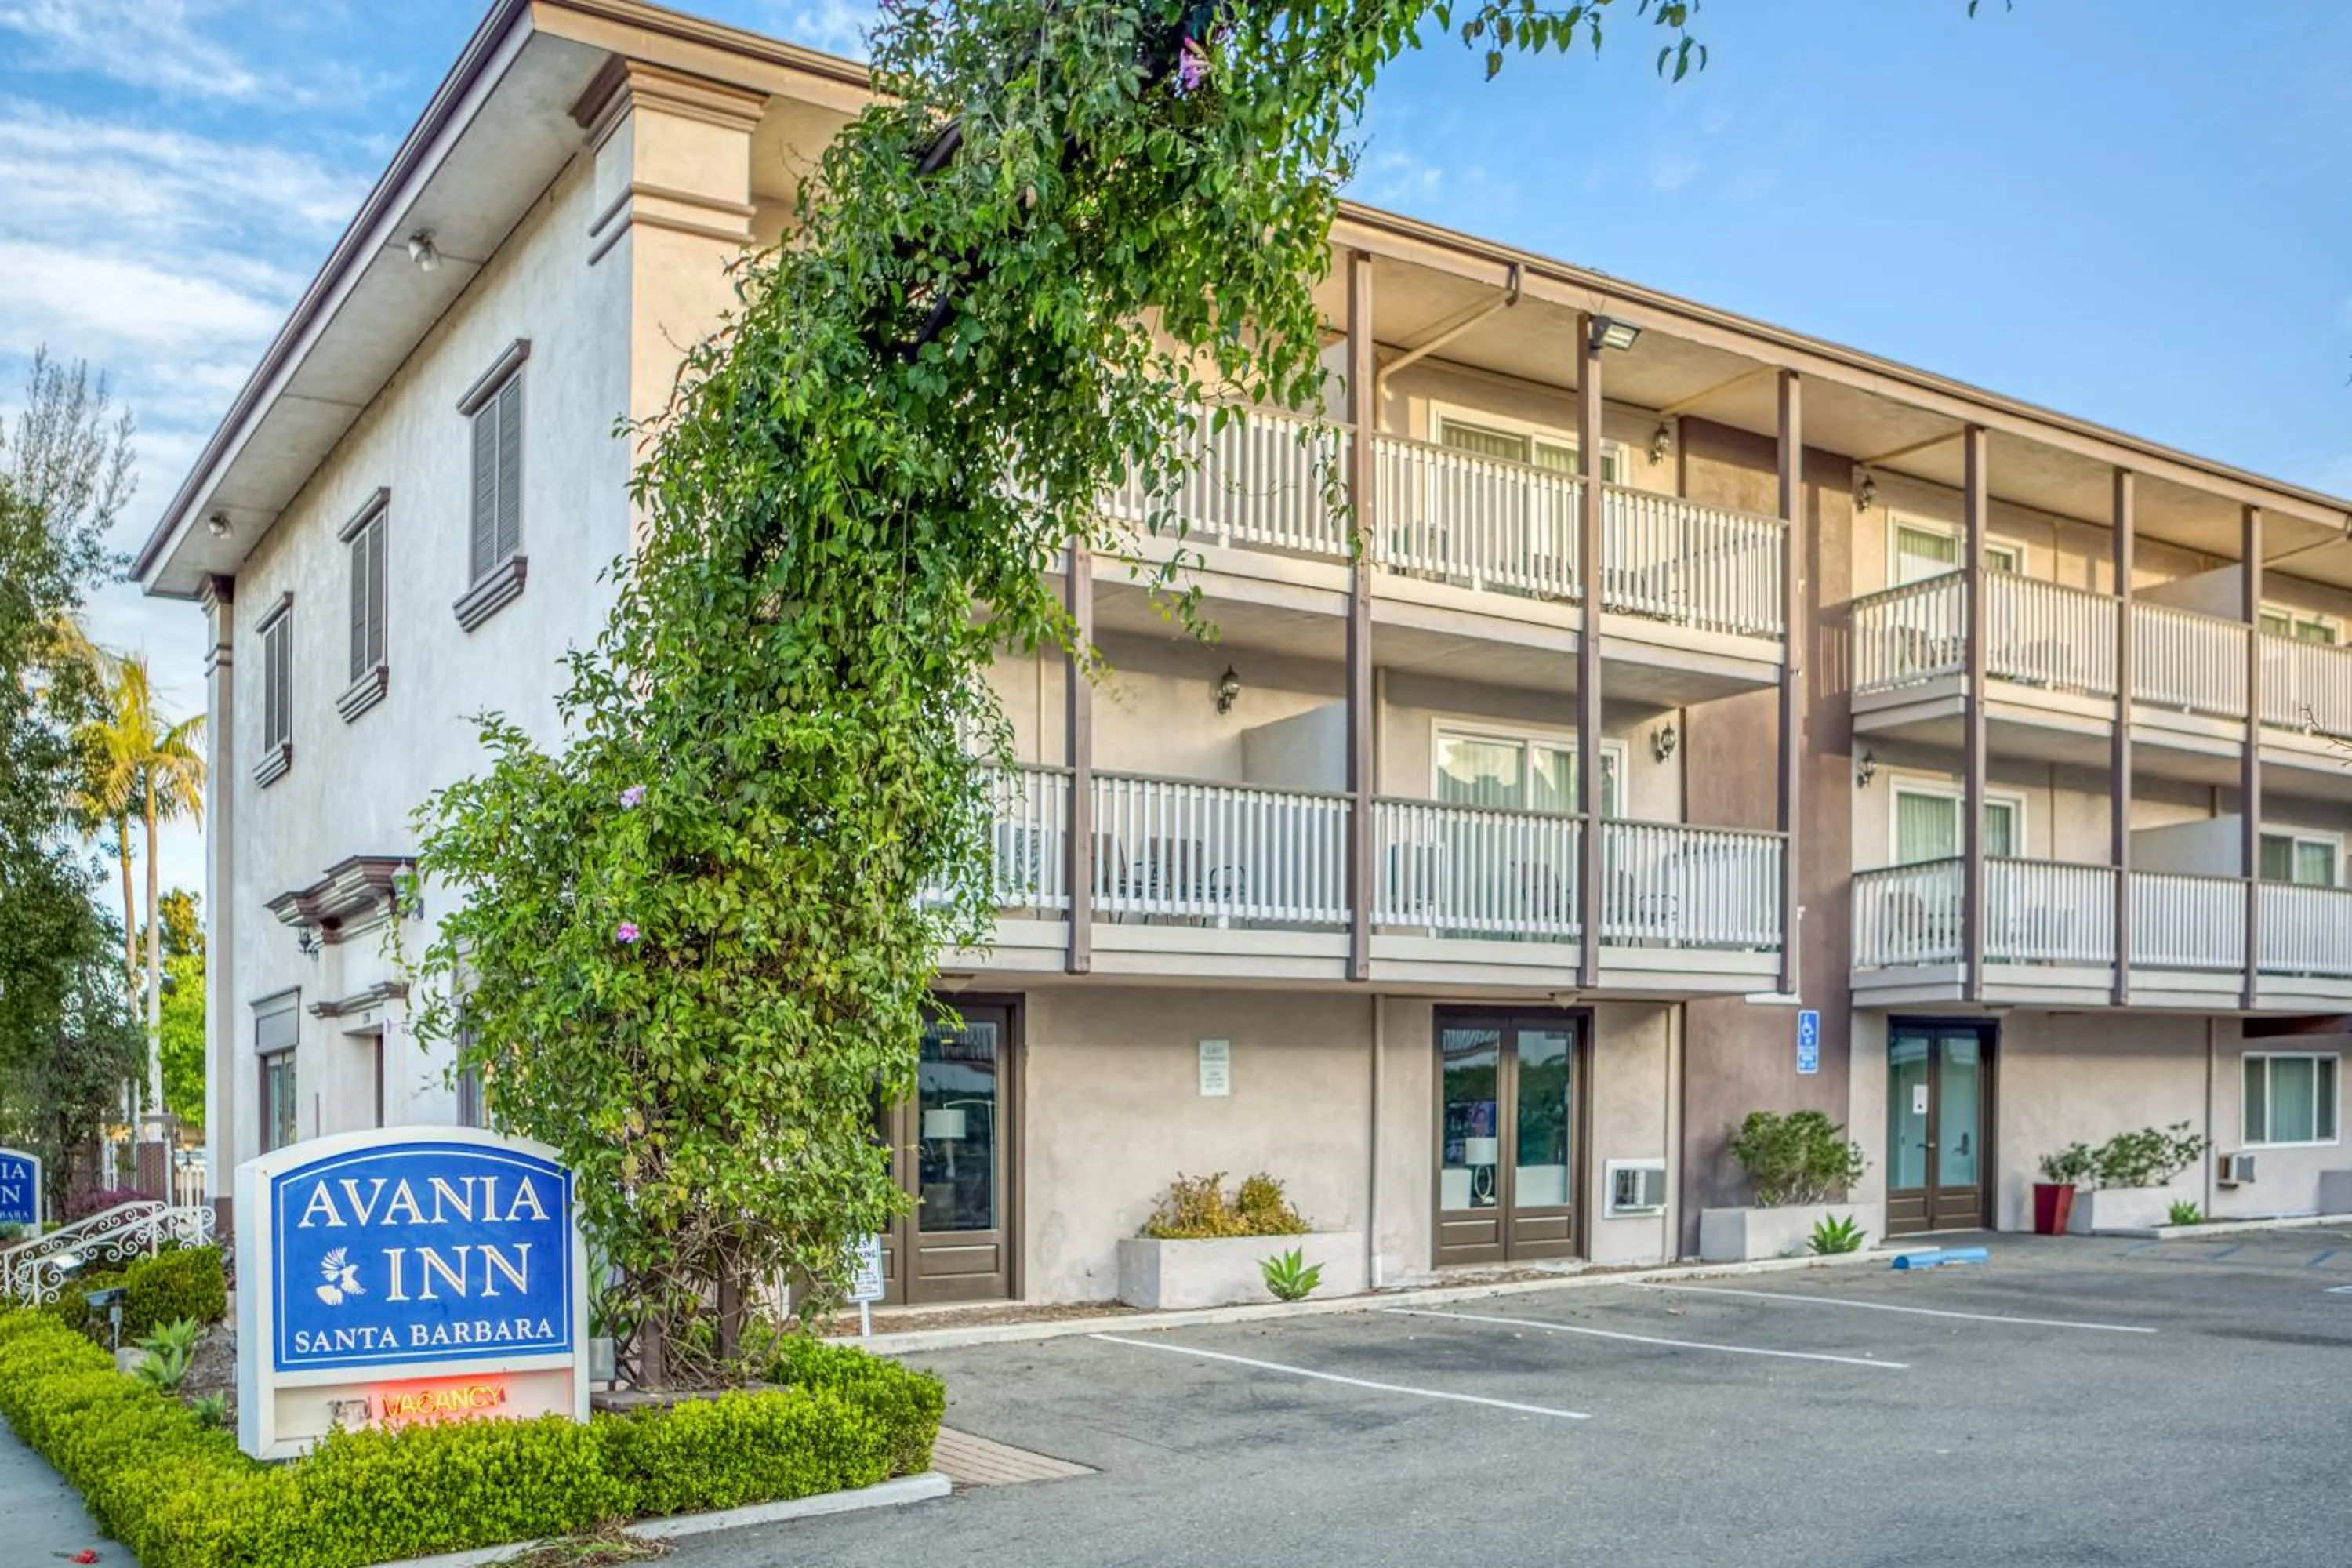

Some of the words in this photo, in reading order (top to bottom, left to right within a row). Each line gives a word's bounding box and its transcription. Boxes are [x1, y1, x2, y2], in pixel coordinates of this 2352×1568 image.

[298, 1176, 550, 1228] AVANIA
[382, 1243, 532, 1301] INN
[295, 1327, 399, 1353] SANTA
[410, 1319, 554, 1346] BARBARA
[383, 1384, 506, 1417] VACANCY
